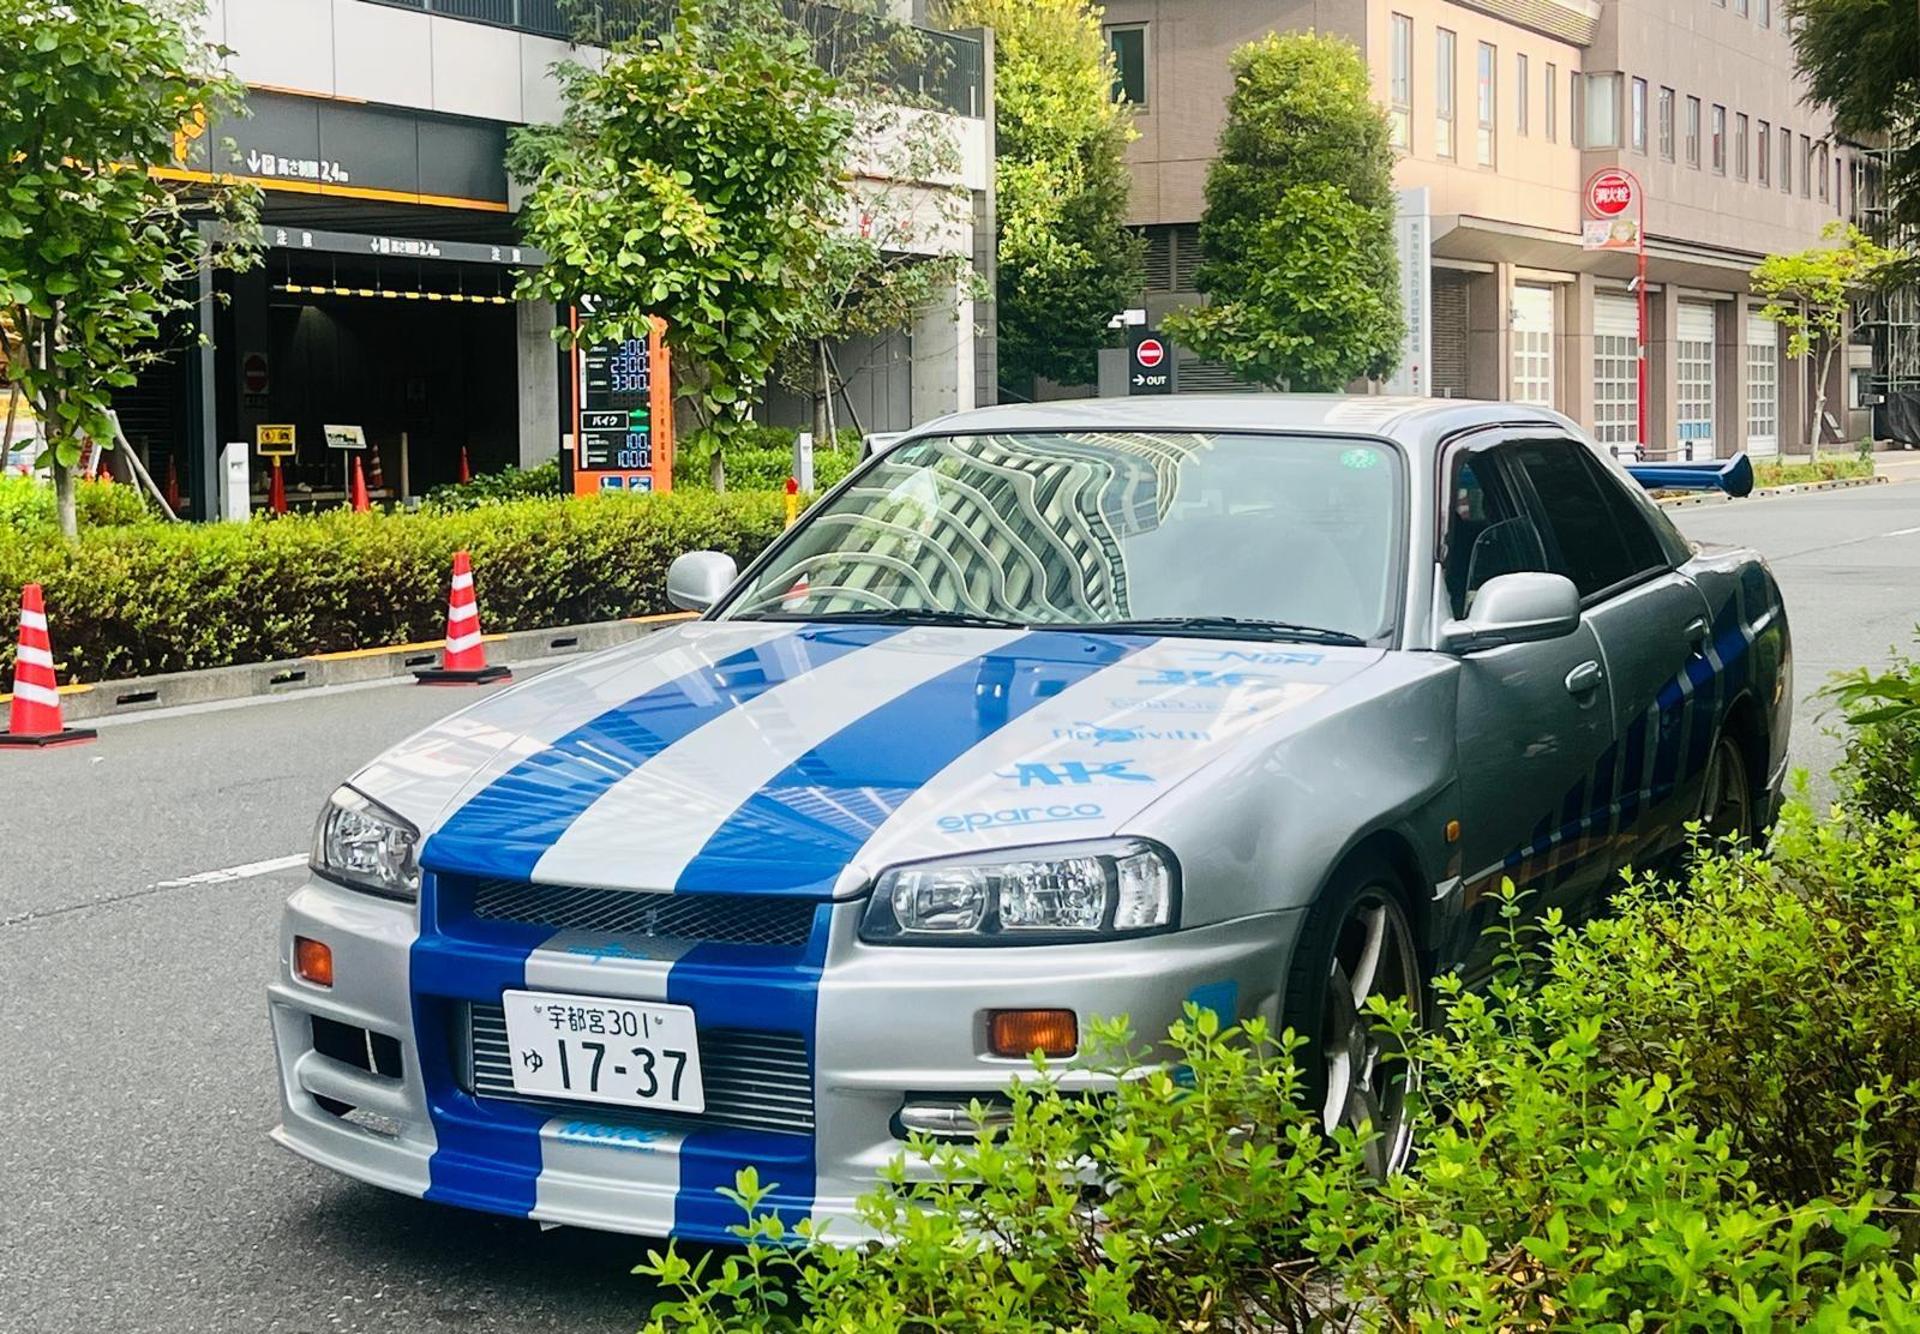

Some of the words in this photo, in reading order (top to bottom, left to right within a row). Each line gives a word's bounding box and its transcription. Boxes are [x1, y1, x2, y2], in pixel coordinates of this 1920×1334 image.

[1595, 186, 1630, 204] 消火栓
[610, 356, 646, 373] 2300
[611, 374, 647, 391] 3300
[1146, 376, 1167, 385] OUT
[592, 416, 618, 426] バイク
[626, 433, 648, 449] 100
[617, 450, 648, 468] 1000
[522, 1049, 543, 1073] ゆ
[557, 1039, 688, 1102] 17-37
